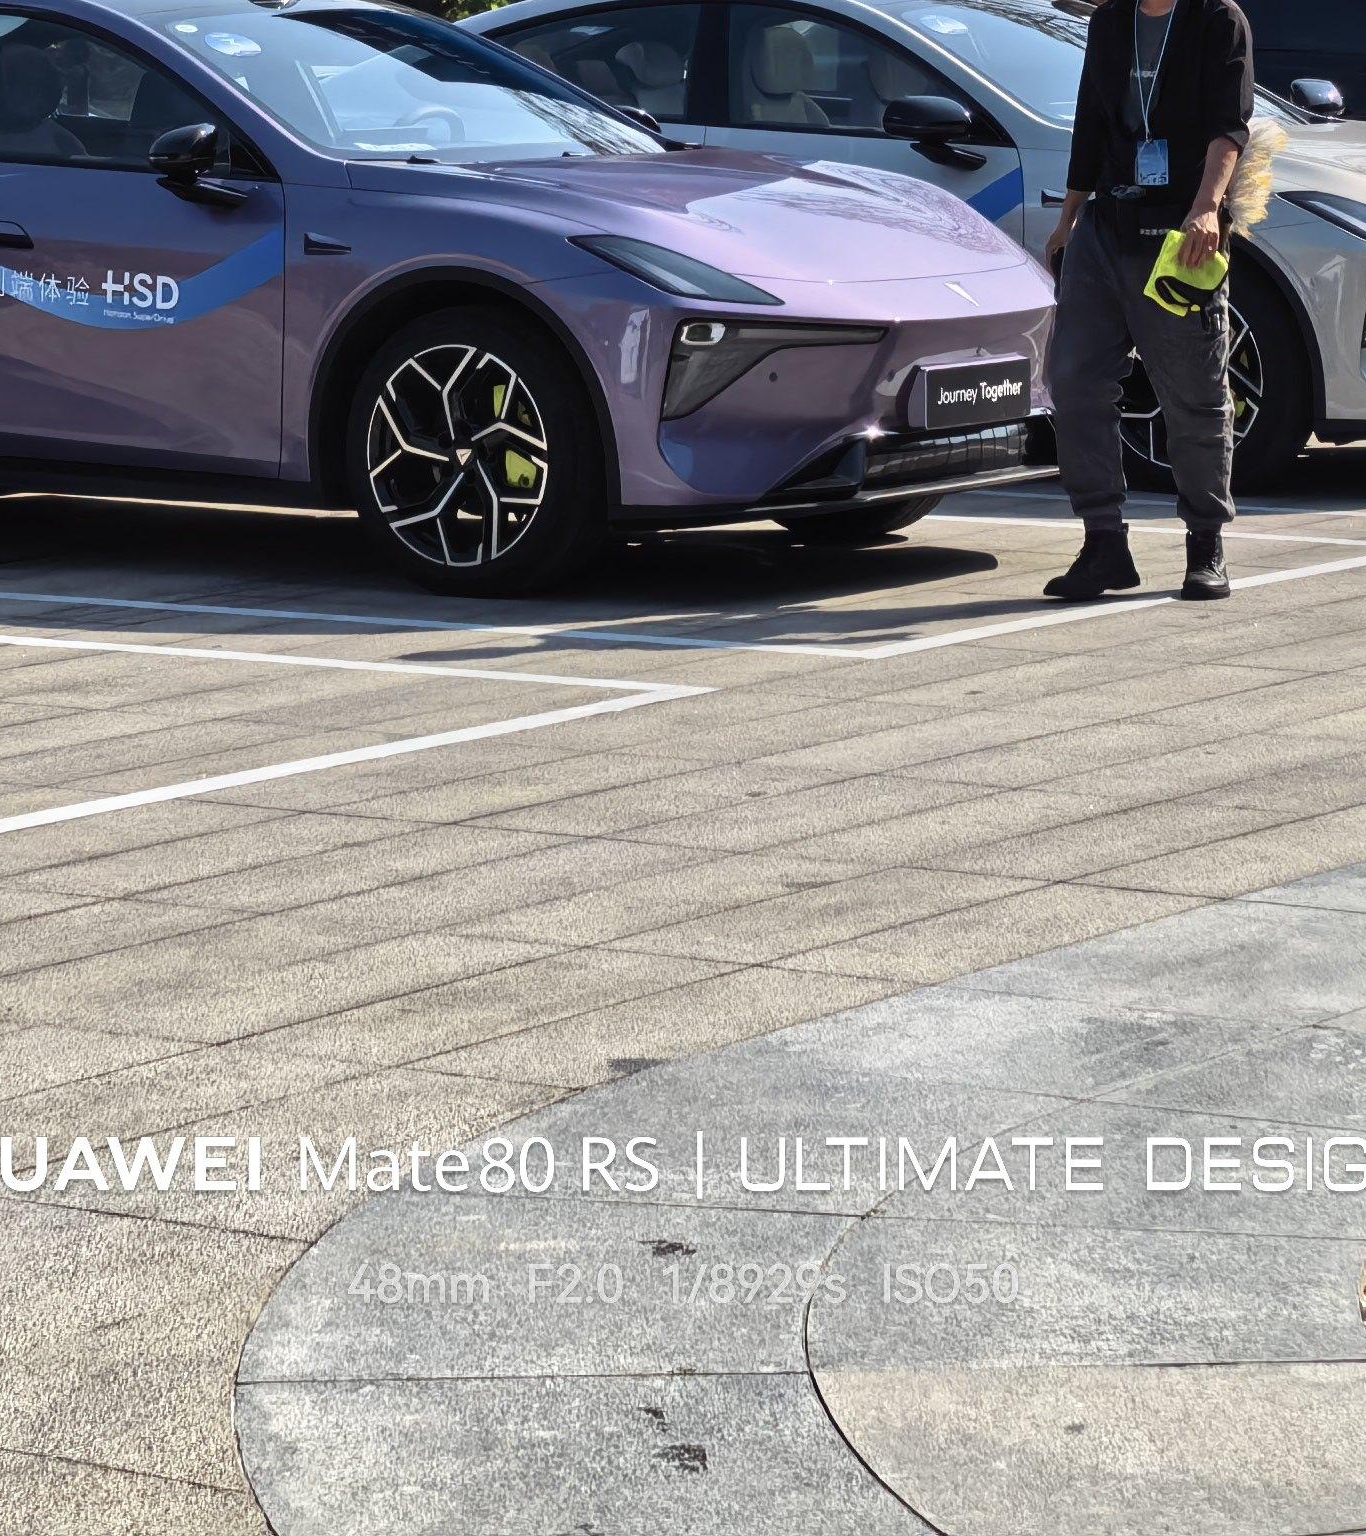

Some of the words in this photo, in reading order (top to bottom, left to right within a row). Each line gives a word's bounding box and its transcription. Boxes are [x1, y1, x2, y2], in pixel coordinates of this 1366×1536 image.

[101, 269, 180, 310] HSD
[937, 386, 978, 406] Journey
[979, 378, 1023, 403] Together
